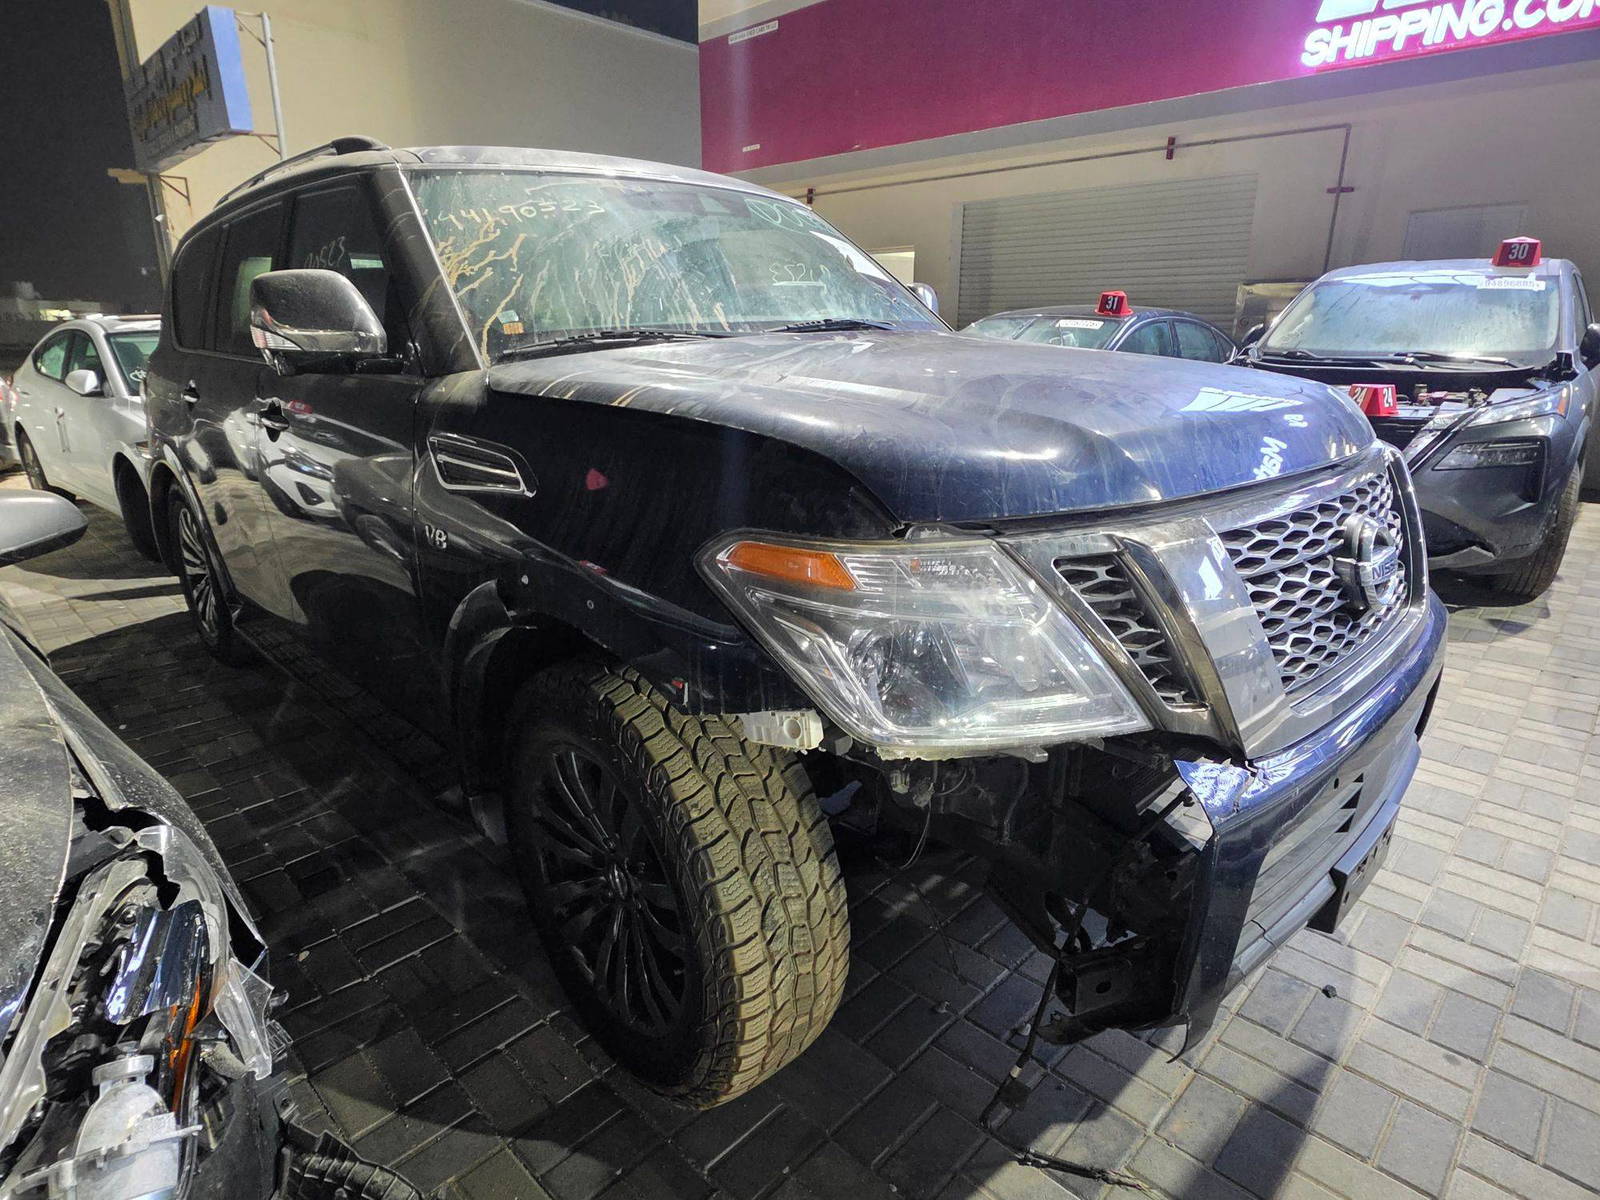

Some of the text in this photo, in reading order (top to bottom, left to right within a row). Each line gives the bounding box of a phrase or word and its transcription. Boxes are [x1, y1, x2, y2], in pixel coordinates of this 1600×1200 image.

[1508, 243, 1529, 260] 30
[1106, 295, 1119, 310] 31
[1383, 387, 1393, 408] 24
[425, 525, 447, 549] V8
